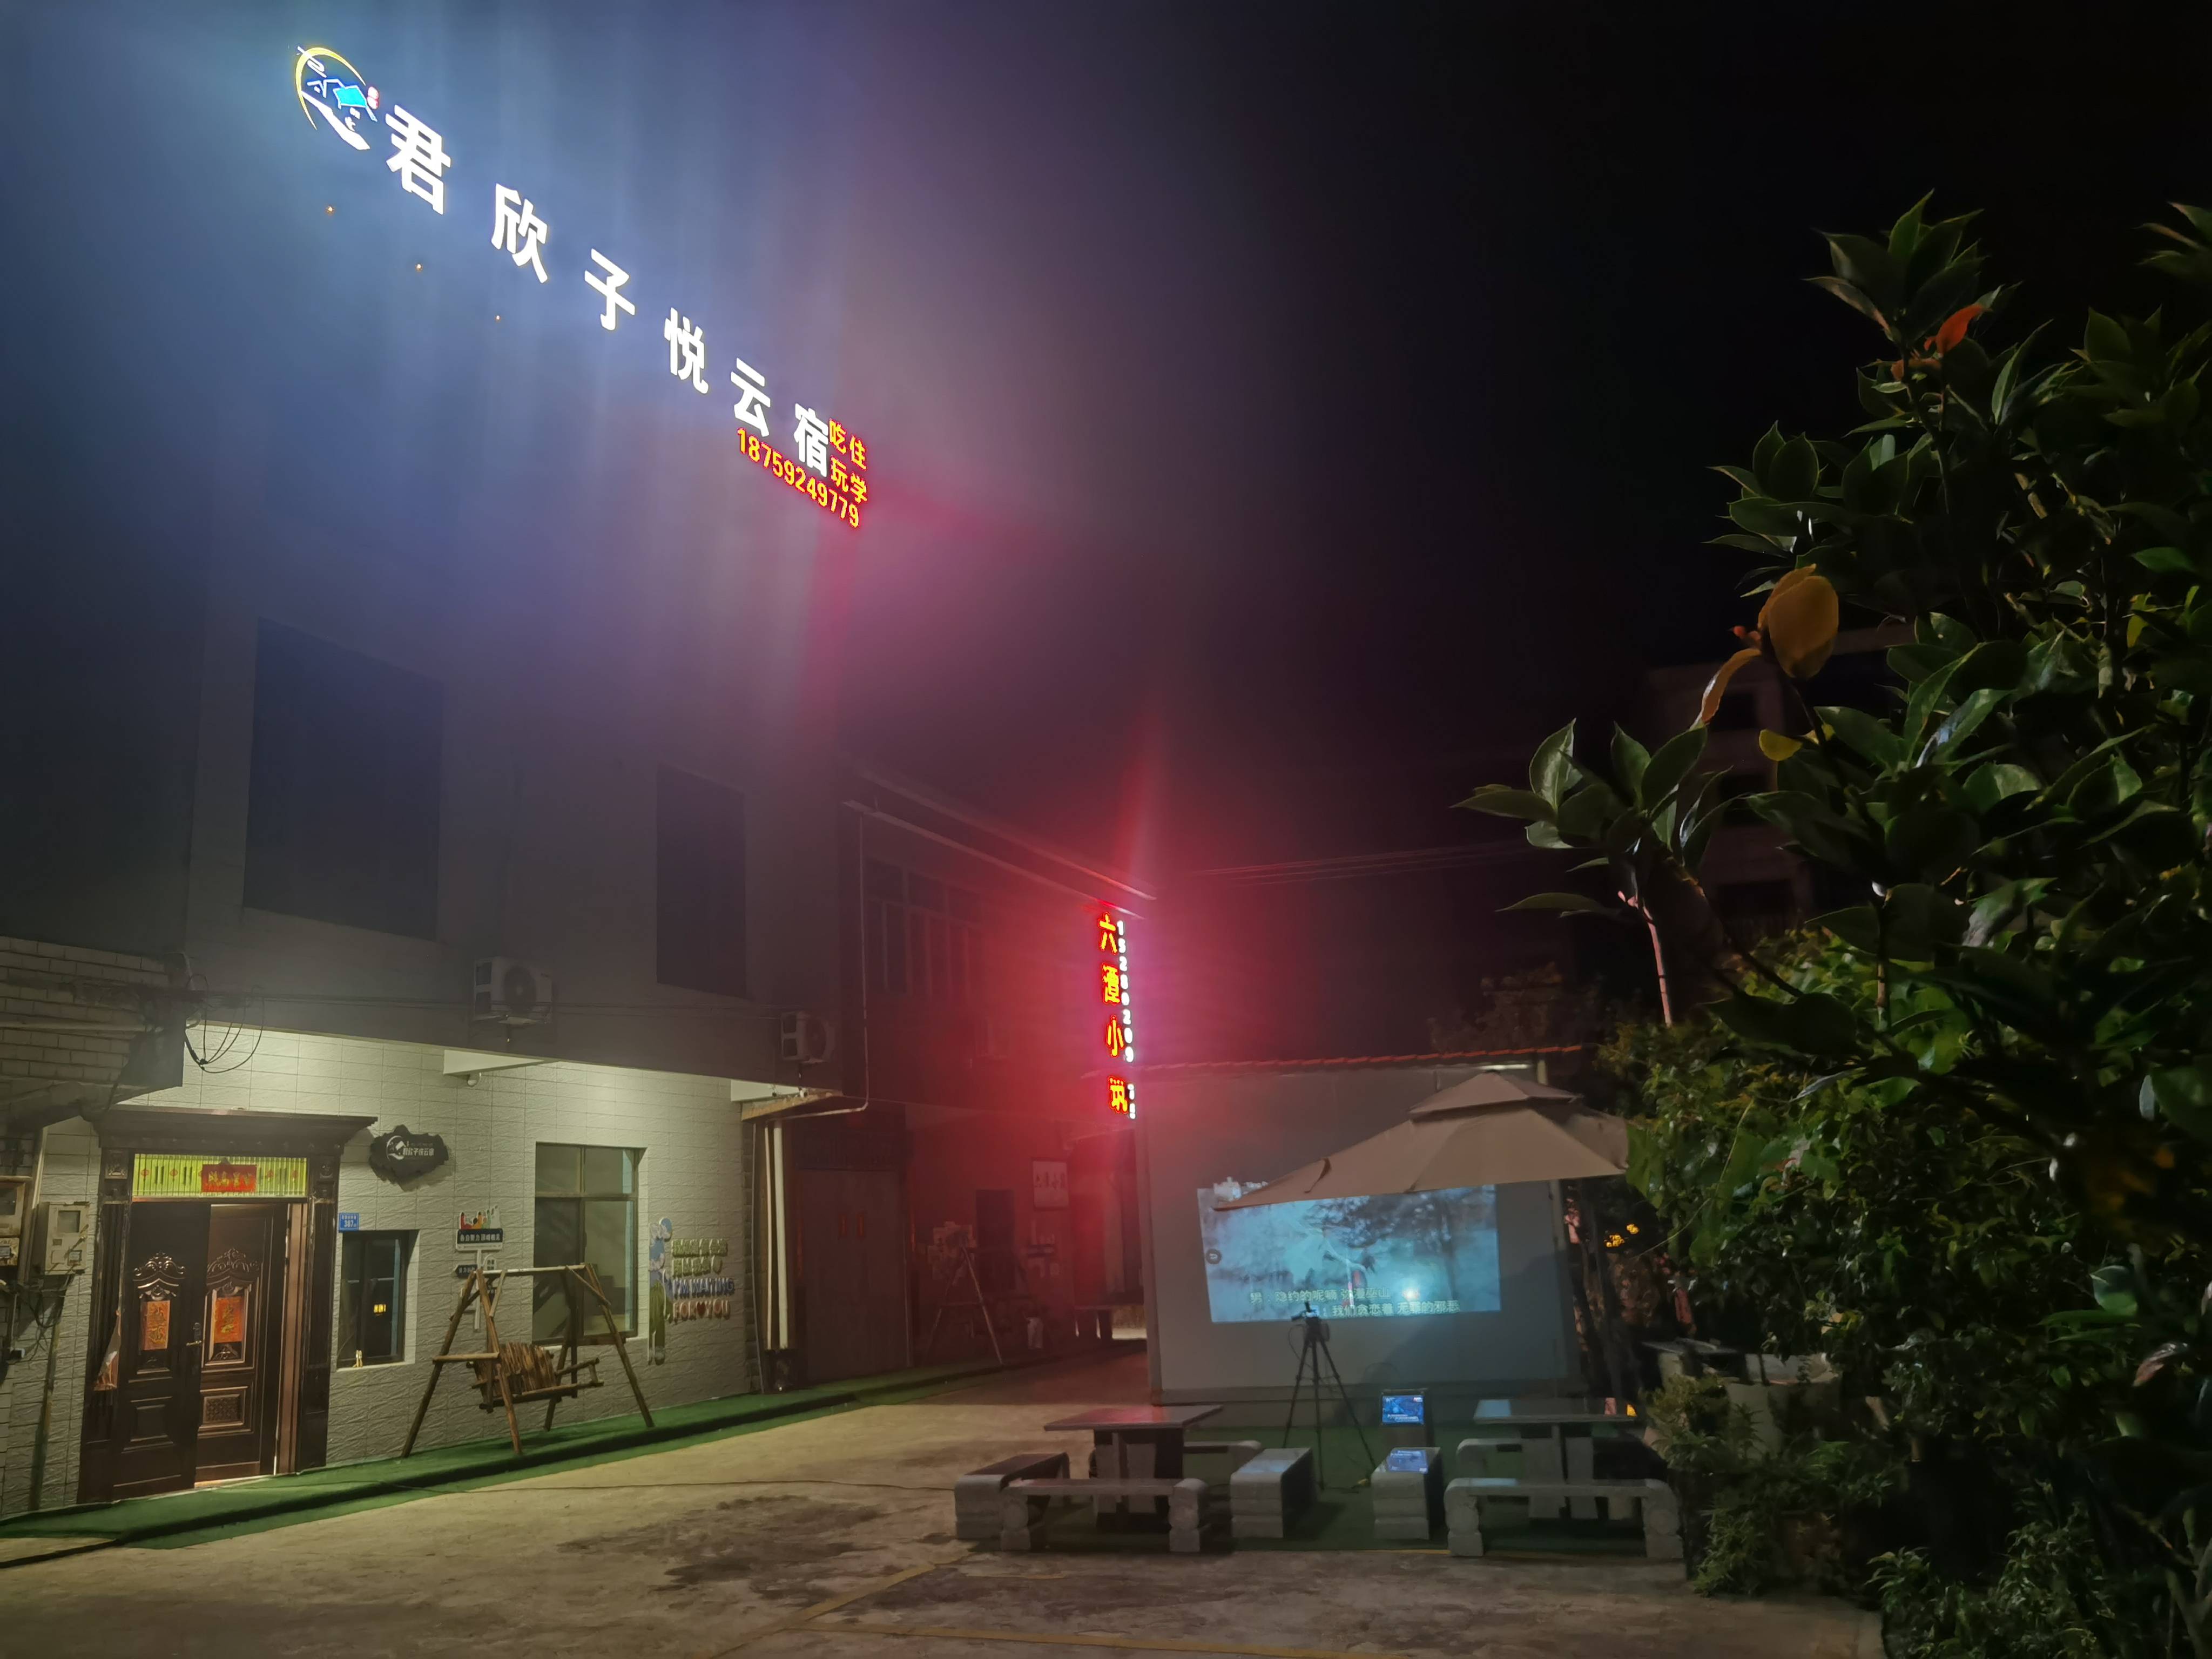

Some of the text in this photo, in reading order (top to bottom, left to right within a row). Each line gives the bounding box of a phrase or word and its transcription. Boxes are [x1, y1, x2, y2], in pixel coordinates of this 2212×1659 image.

[385, 104, 830, 477] 君欣子悦云宿
[828, 418, 868, 471] 吃住
[737, 427, 860, 529] 18759249779
[830, 456, 868, 504] 玩学
[673, 1298, 731, 1321] FOR YOU
[691, 1277, 734, 1296] WAITING
